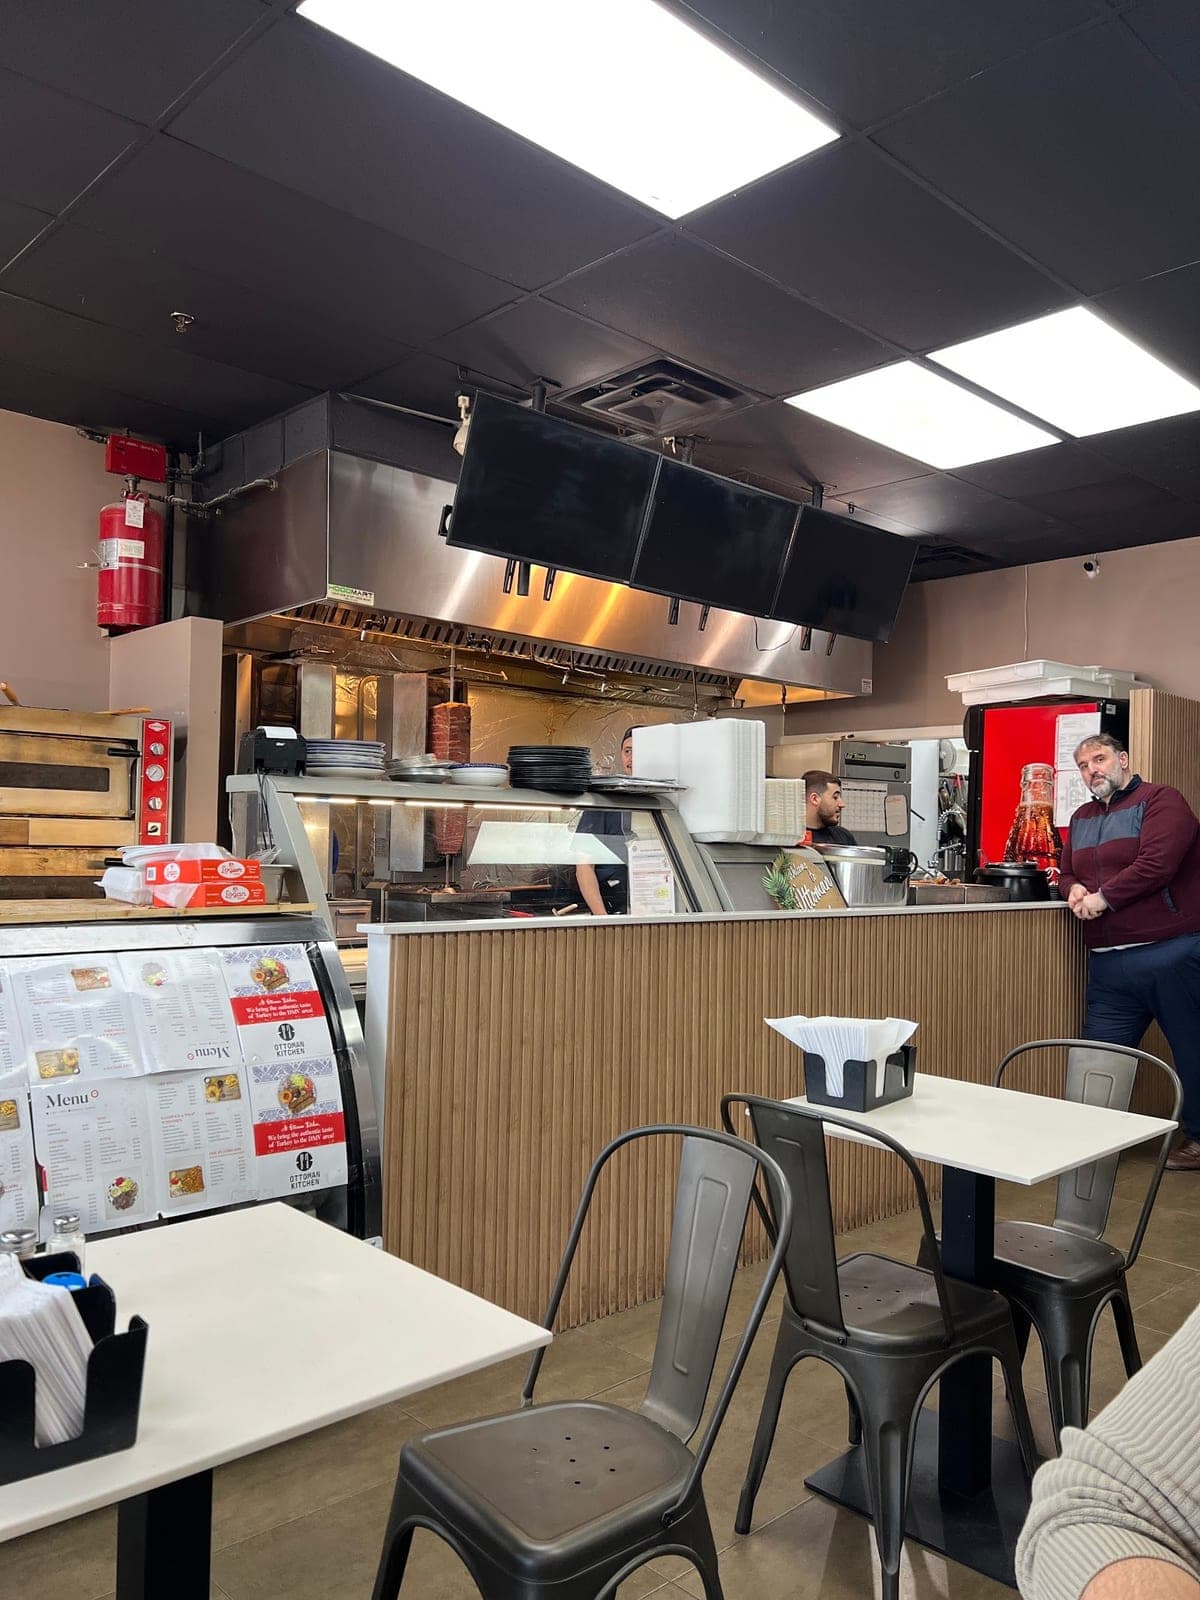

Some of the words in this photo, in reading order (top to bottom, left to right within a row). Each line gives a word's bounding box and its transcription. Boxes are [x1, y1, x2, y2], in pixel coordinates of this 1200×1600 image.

[274, 1041, 305, 1051] OTTOMAN
[195, 1046, 230, 1059] Menu
[276, 1048, 305, 1057] KITCHEN
[46, 1093, 89, 1109] Menu
[289, 1171, 321, 1183] OTTOMAN
[290, 1179, 320, 1189] KITCHEN
